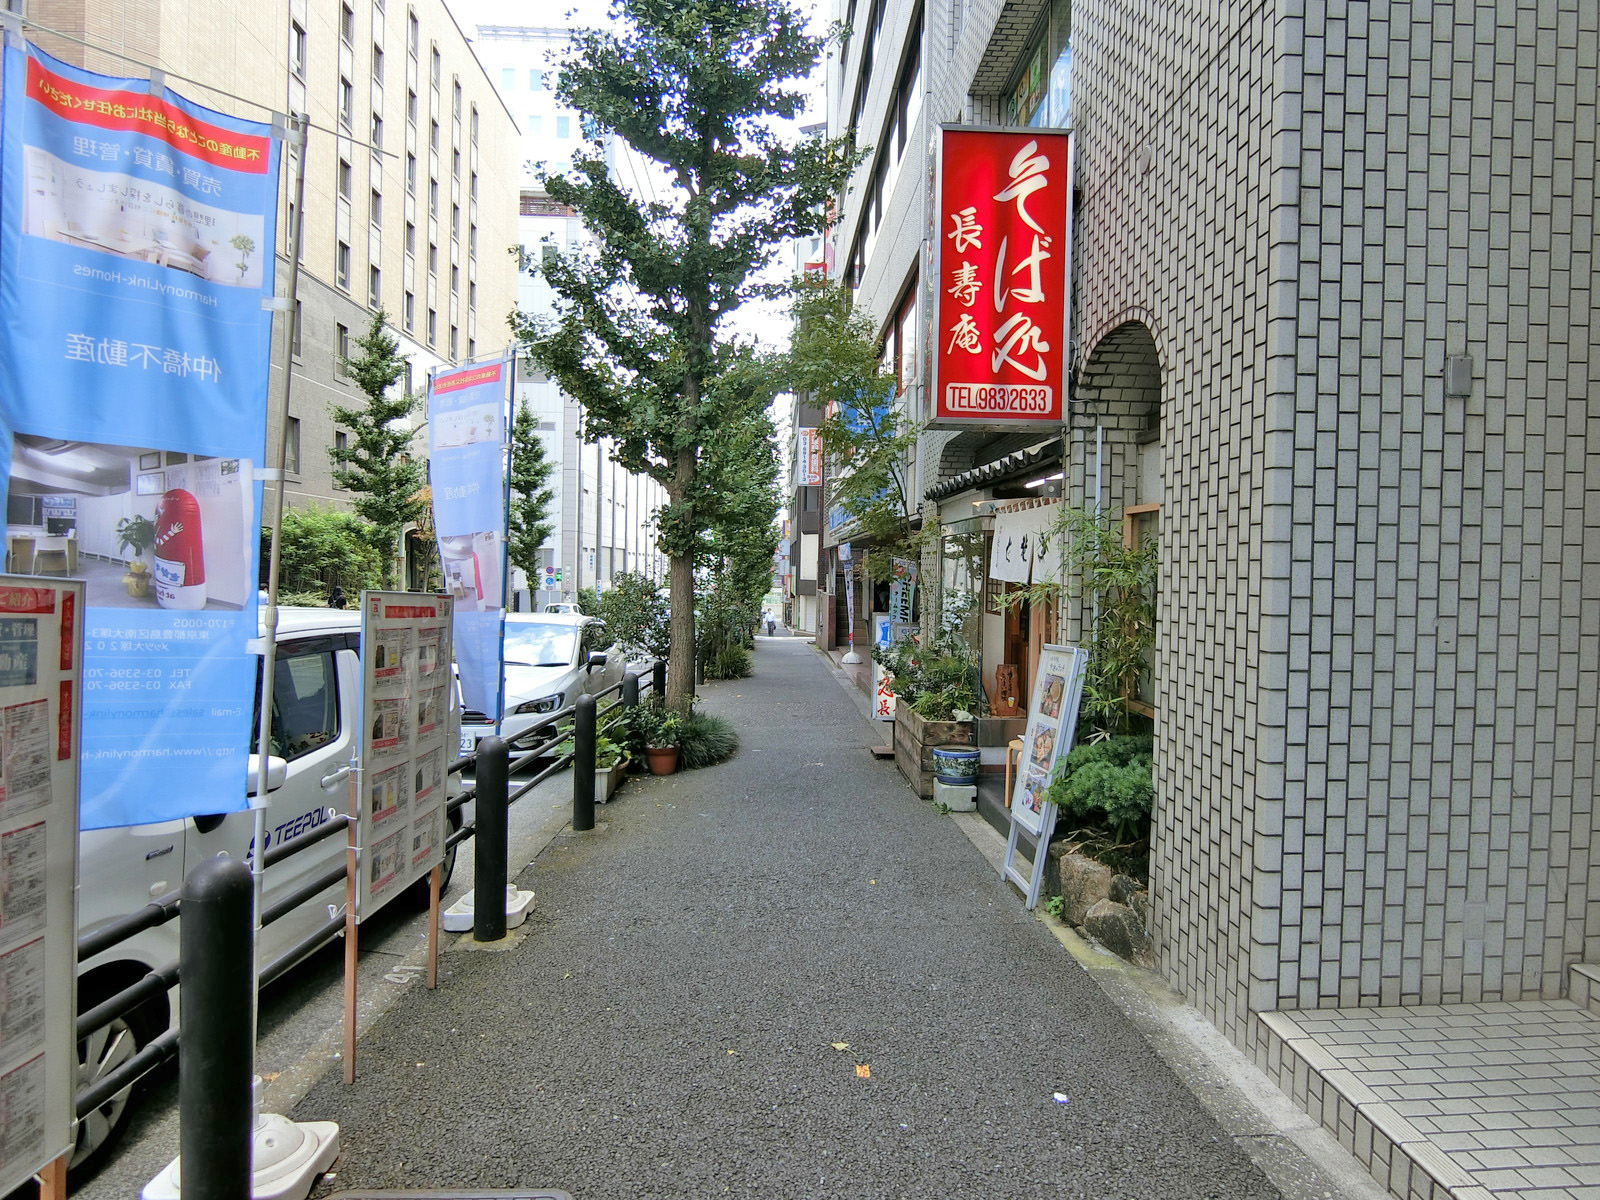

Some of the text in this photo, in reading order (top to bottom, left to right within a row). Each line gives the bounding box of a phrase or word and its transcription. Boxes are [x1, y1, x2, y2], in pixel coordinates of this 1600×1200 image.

[947, 206, 983, 355] 長寿庵
[991, 139, 1051, 382] そば処
[275, 806, 328, 845] TEEPOL
